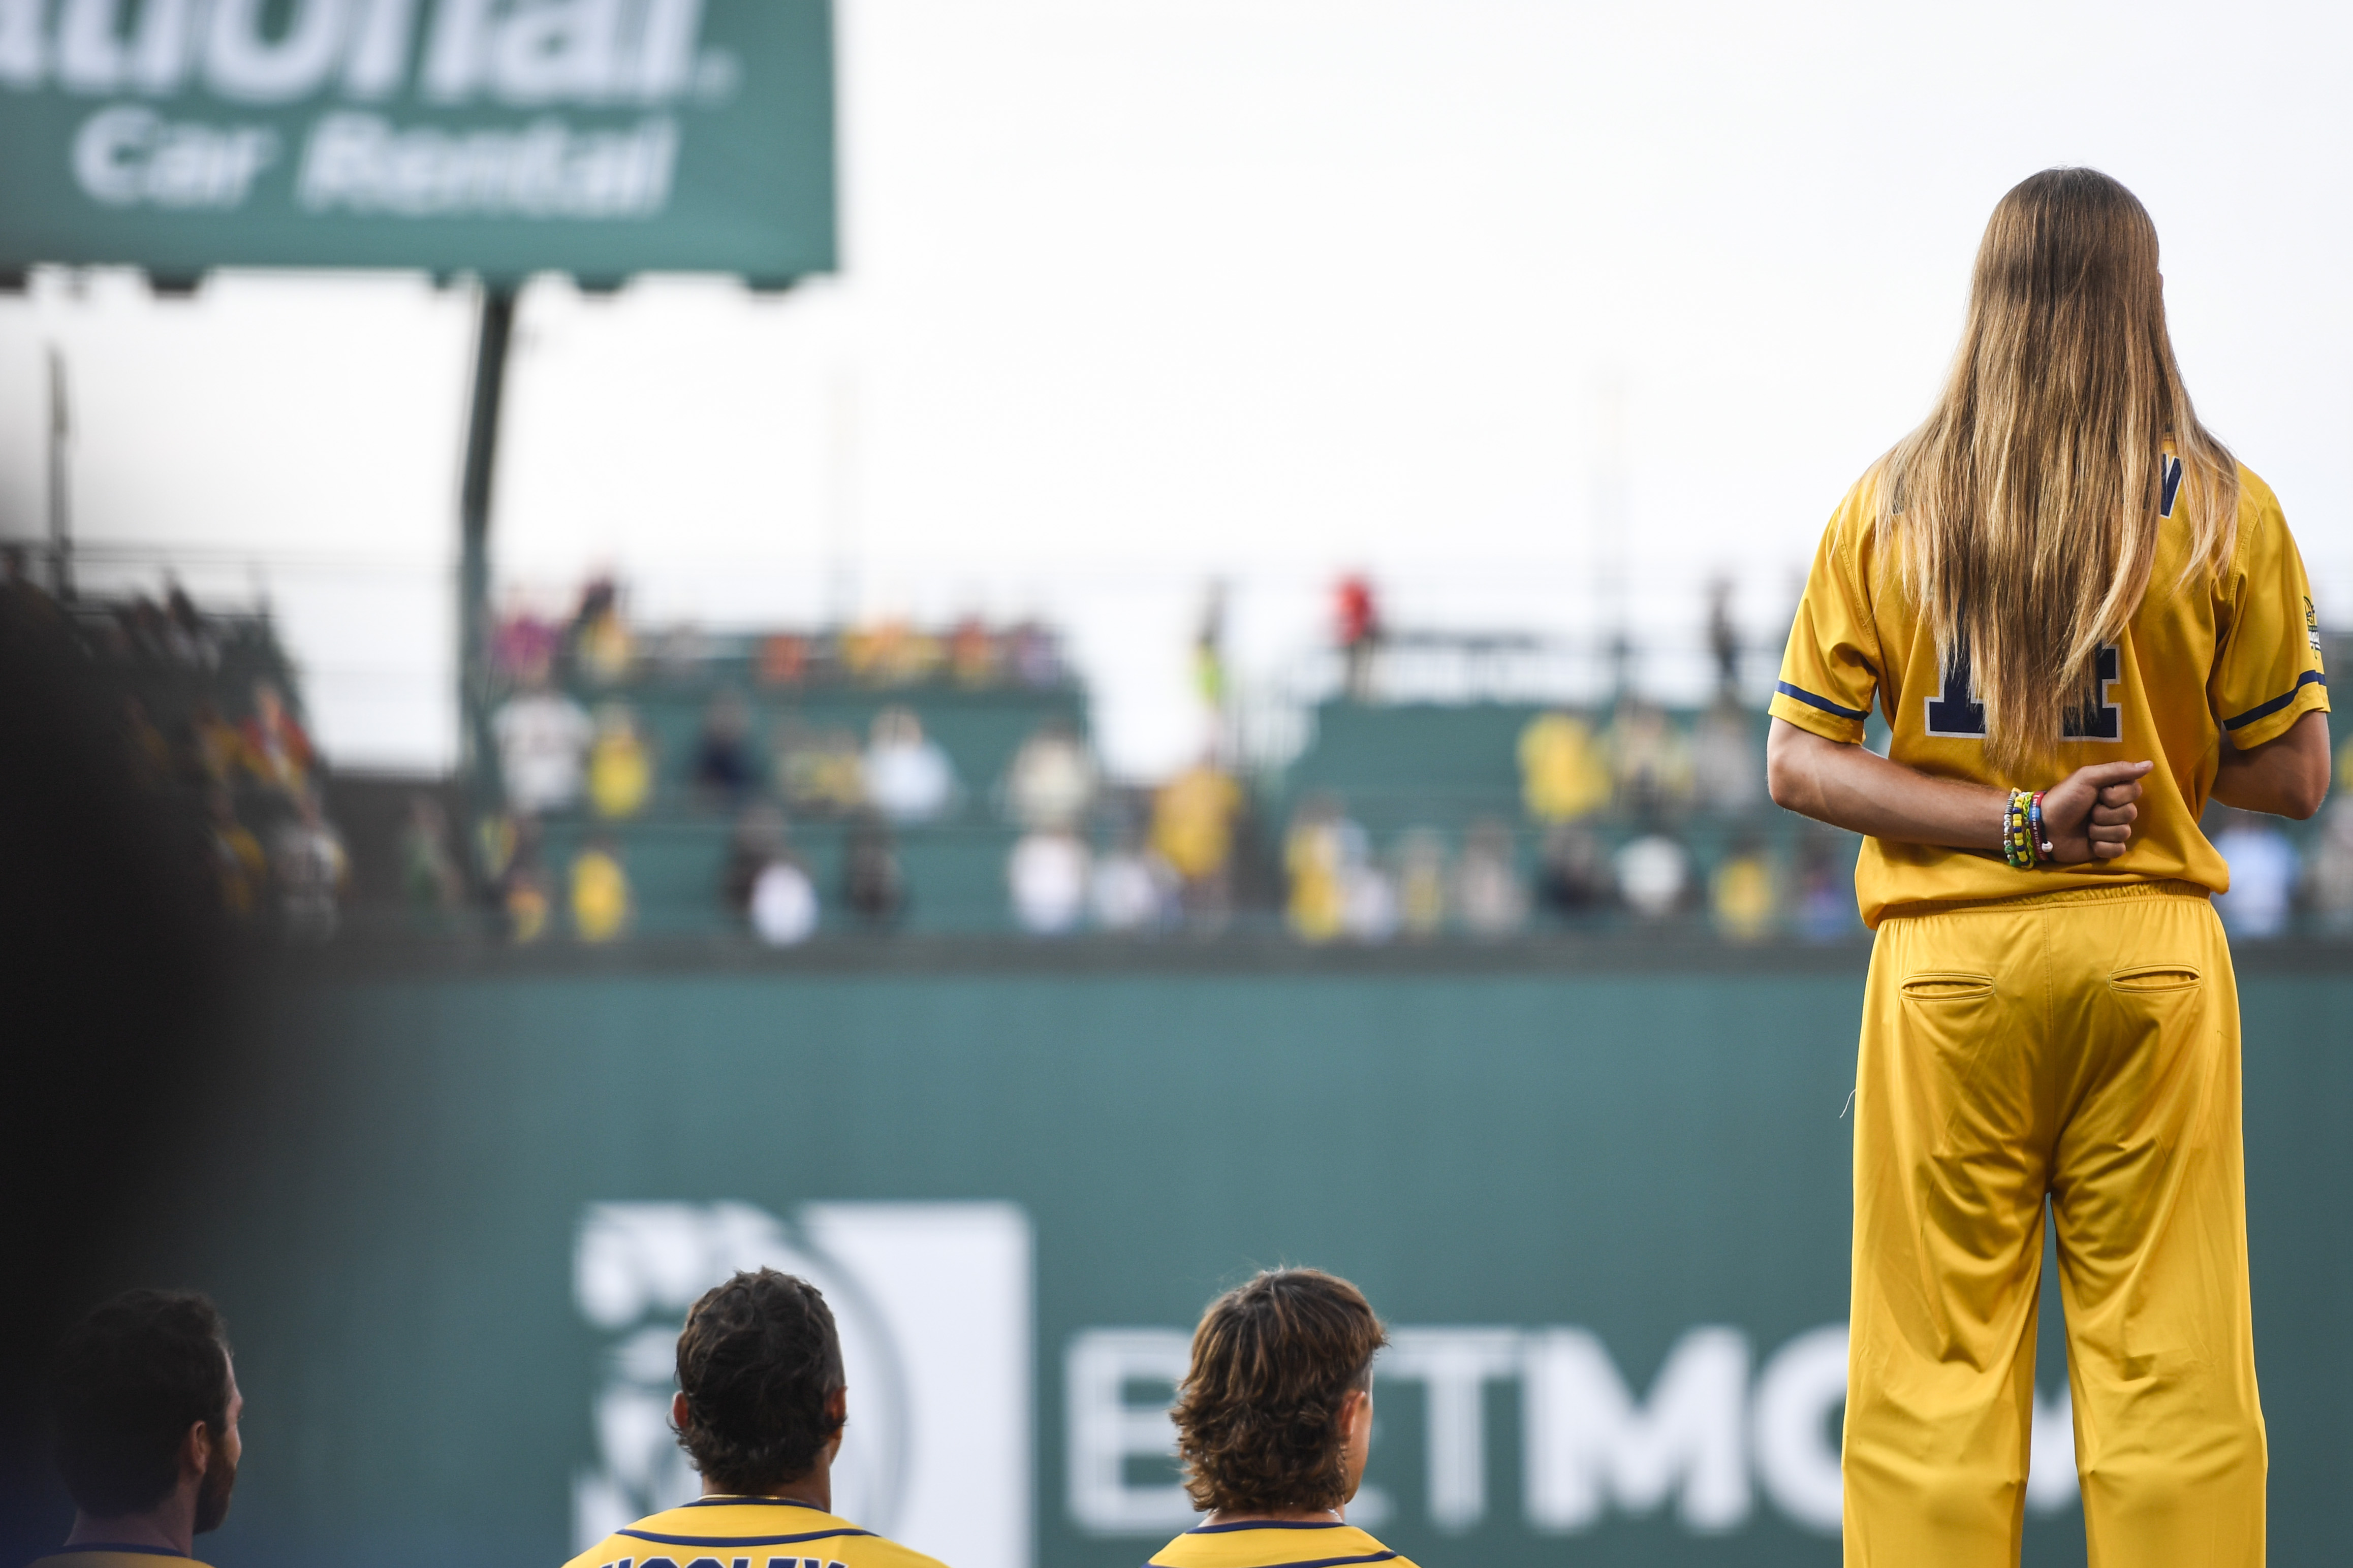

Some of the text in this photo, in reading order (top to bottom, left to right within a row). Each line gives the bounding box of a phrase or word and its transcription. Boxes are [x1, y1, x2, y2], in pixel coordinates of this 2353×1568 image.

[73, 108, 677, 216] Car Rental
[1064, 1327, 2082, 1530] BTM
